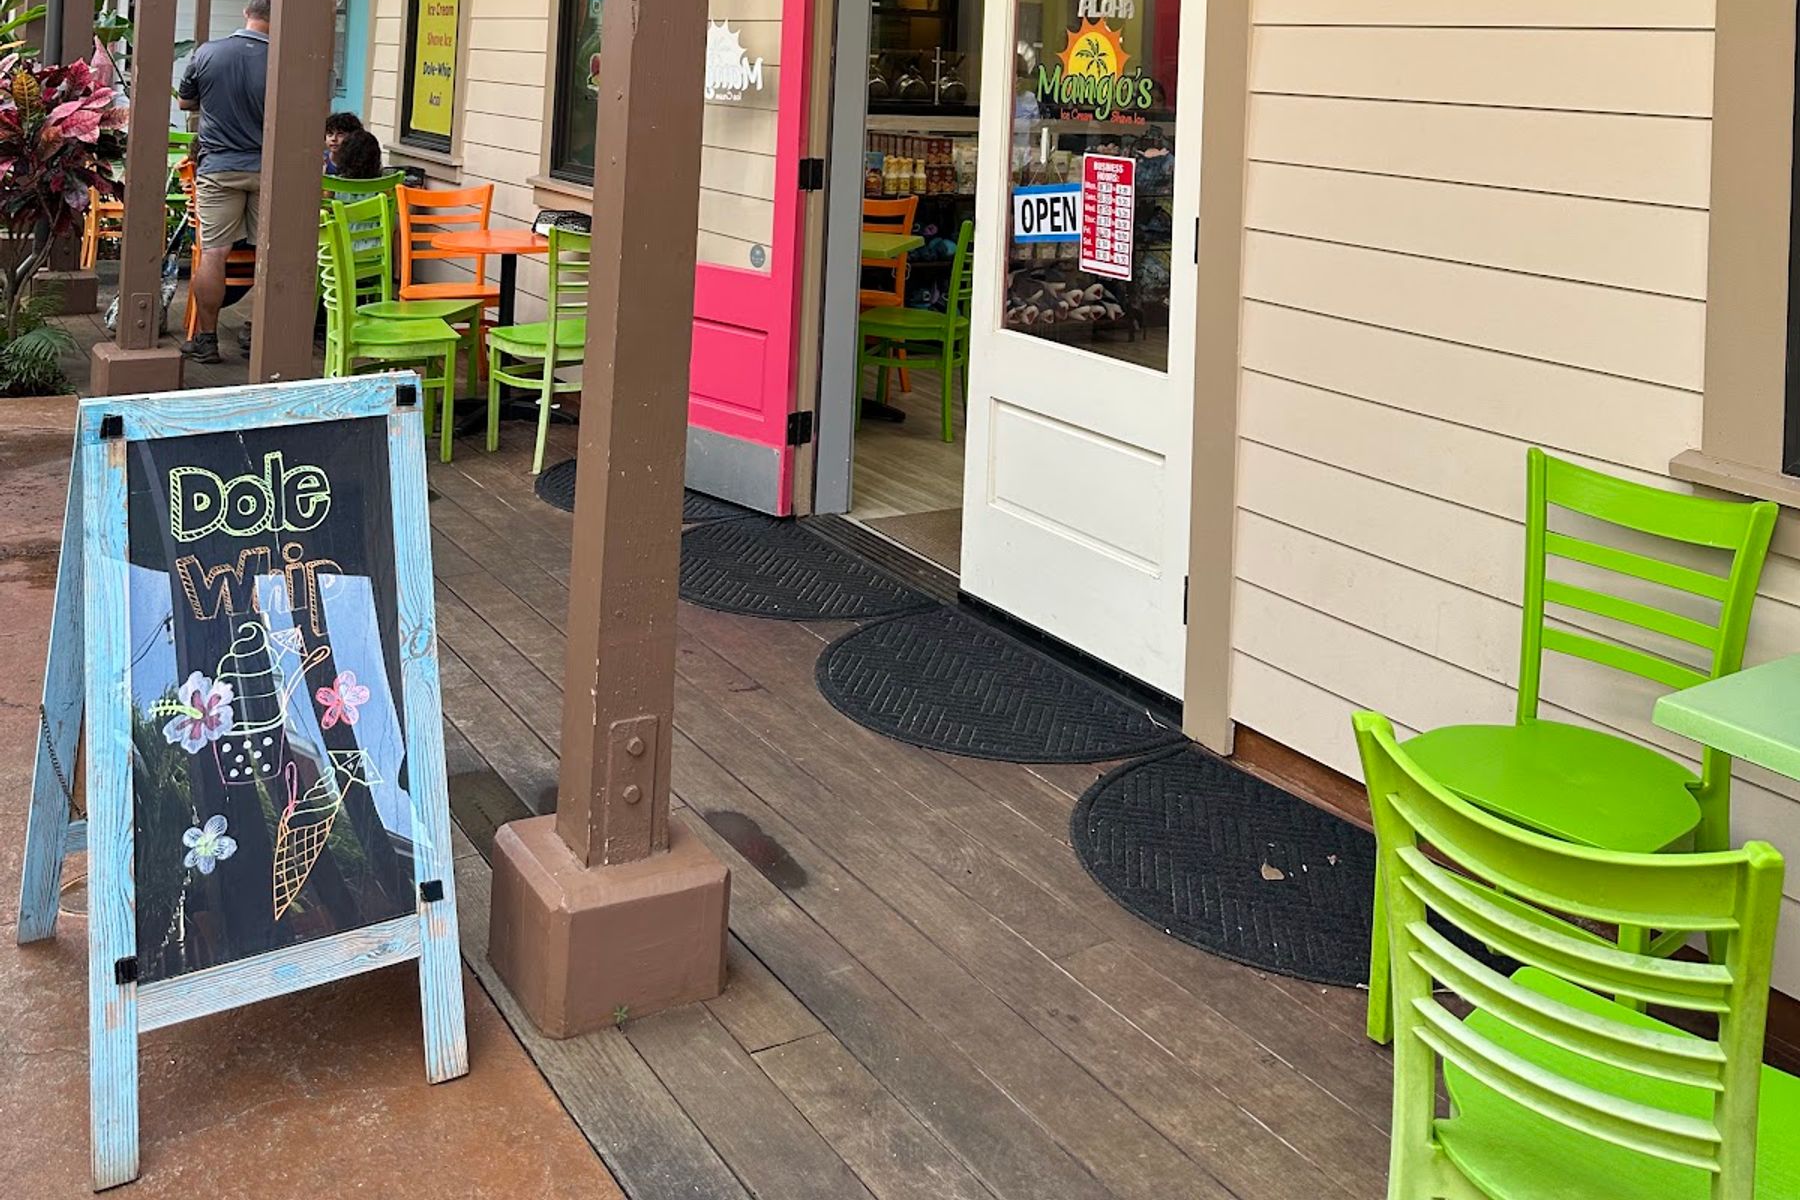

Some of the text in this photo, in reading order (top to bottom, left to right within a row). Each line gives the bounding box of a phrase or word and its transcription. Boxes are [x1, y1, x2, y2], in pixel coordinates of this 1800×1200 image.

[1037, 63, 1153, 121] Mango's
[1021, 196, 1077, 233] OPEN
[169, 451, 331, 542] Dole
[175, 542, 343, 637] Whip
